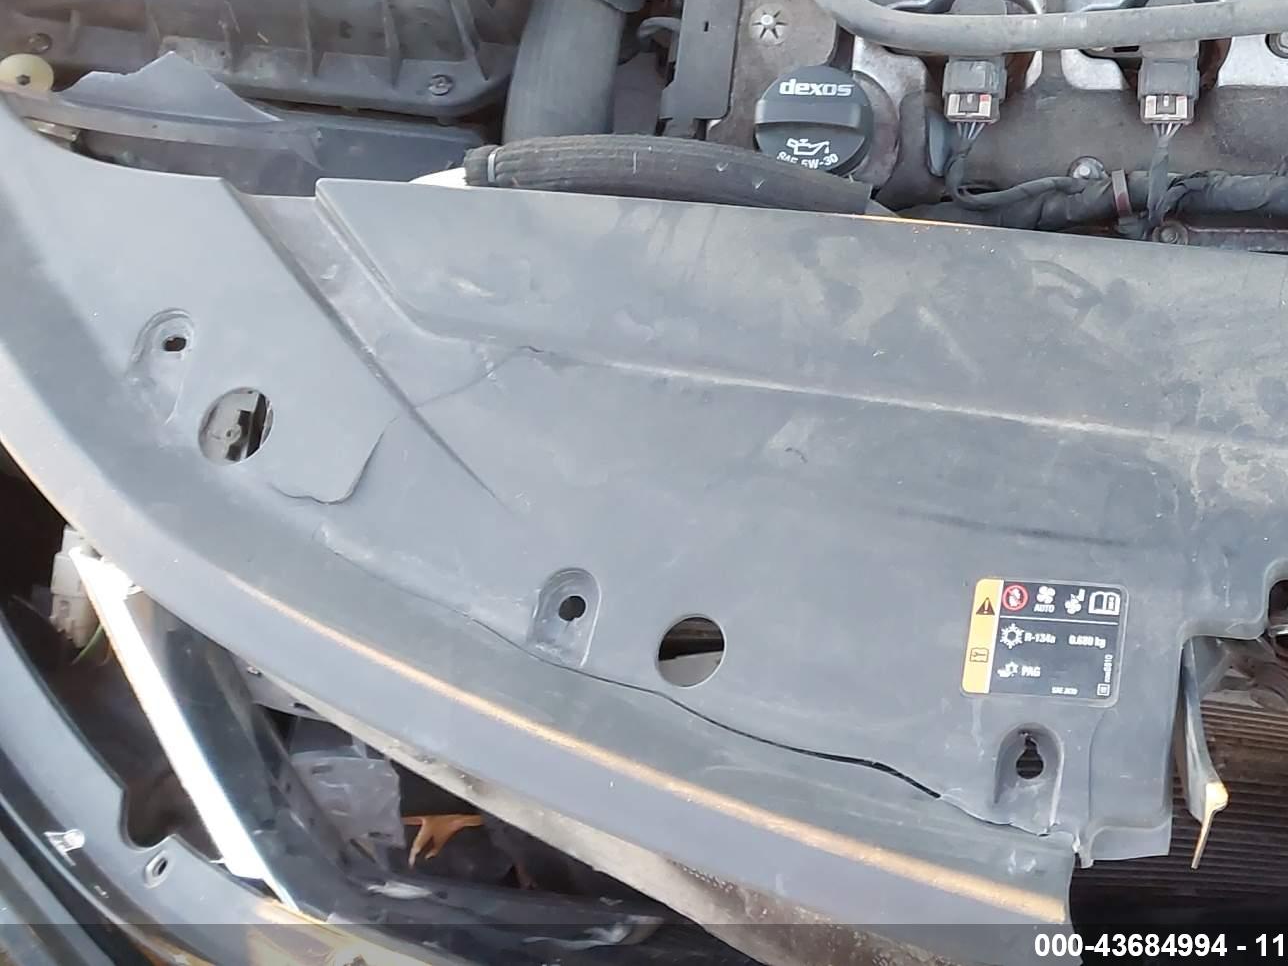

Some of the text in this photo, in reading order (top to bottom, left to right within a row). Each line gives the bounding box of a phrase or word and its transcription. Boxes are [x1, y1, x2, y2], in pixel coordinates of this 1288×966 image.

[779, 78, 855, 96] dexos
[801, 153, 839, 169] 5W-30
[1033, 603, 1055, 613] AUTO
[1024, 632, 1056, 644] R-134a
[1095, 636, 1106, 649] kg
[1021, 665, 1041, 677] PAG
